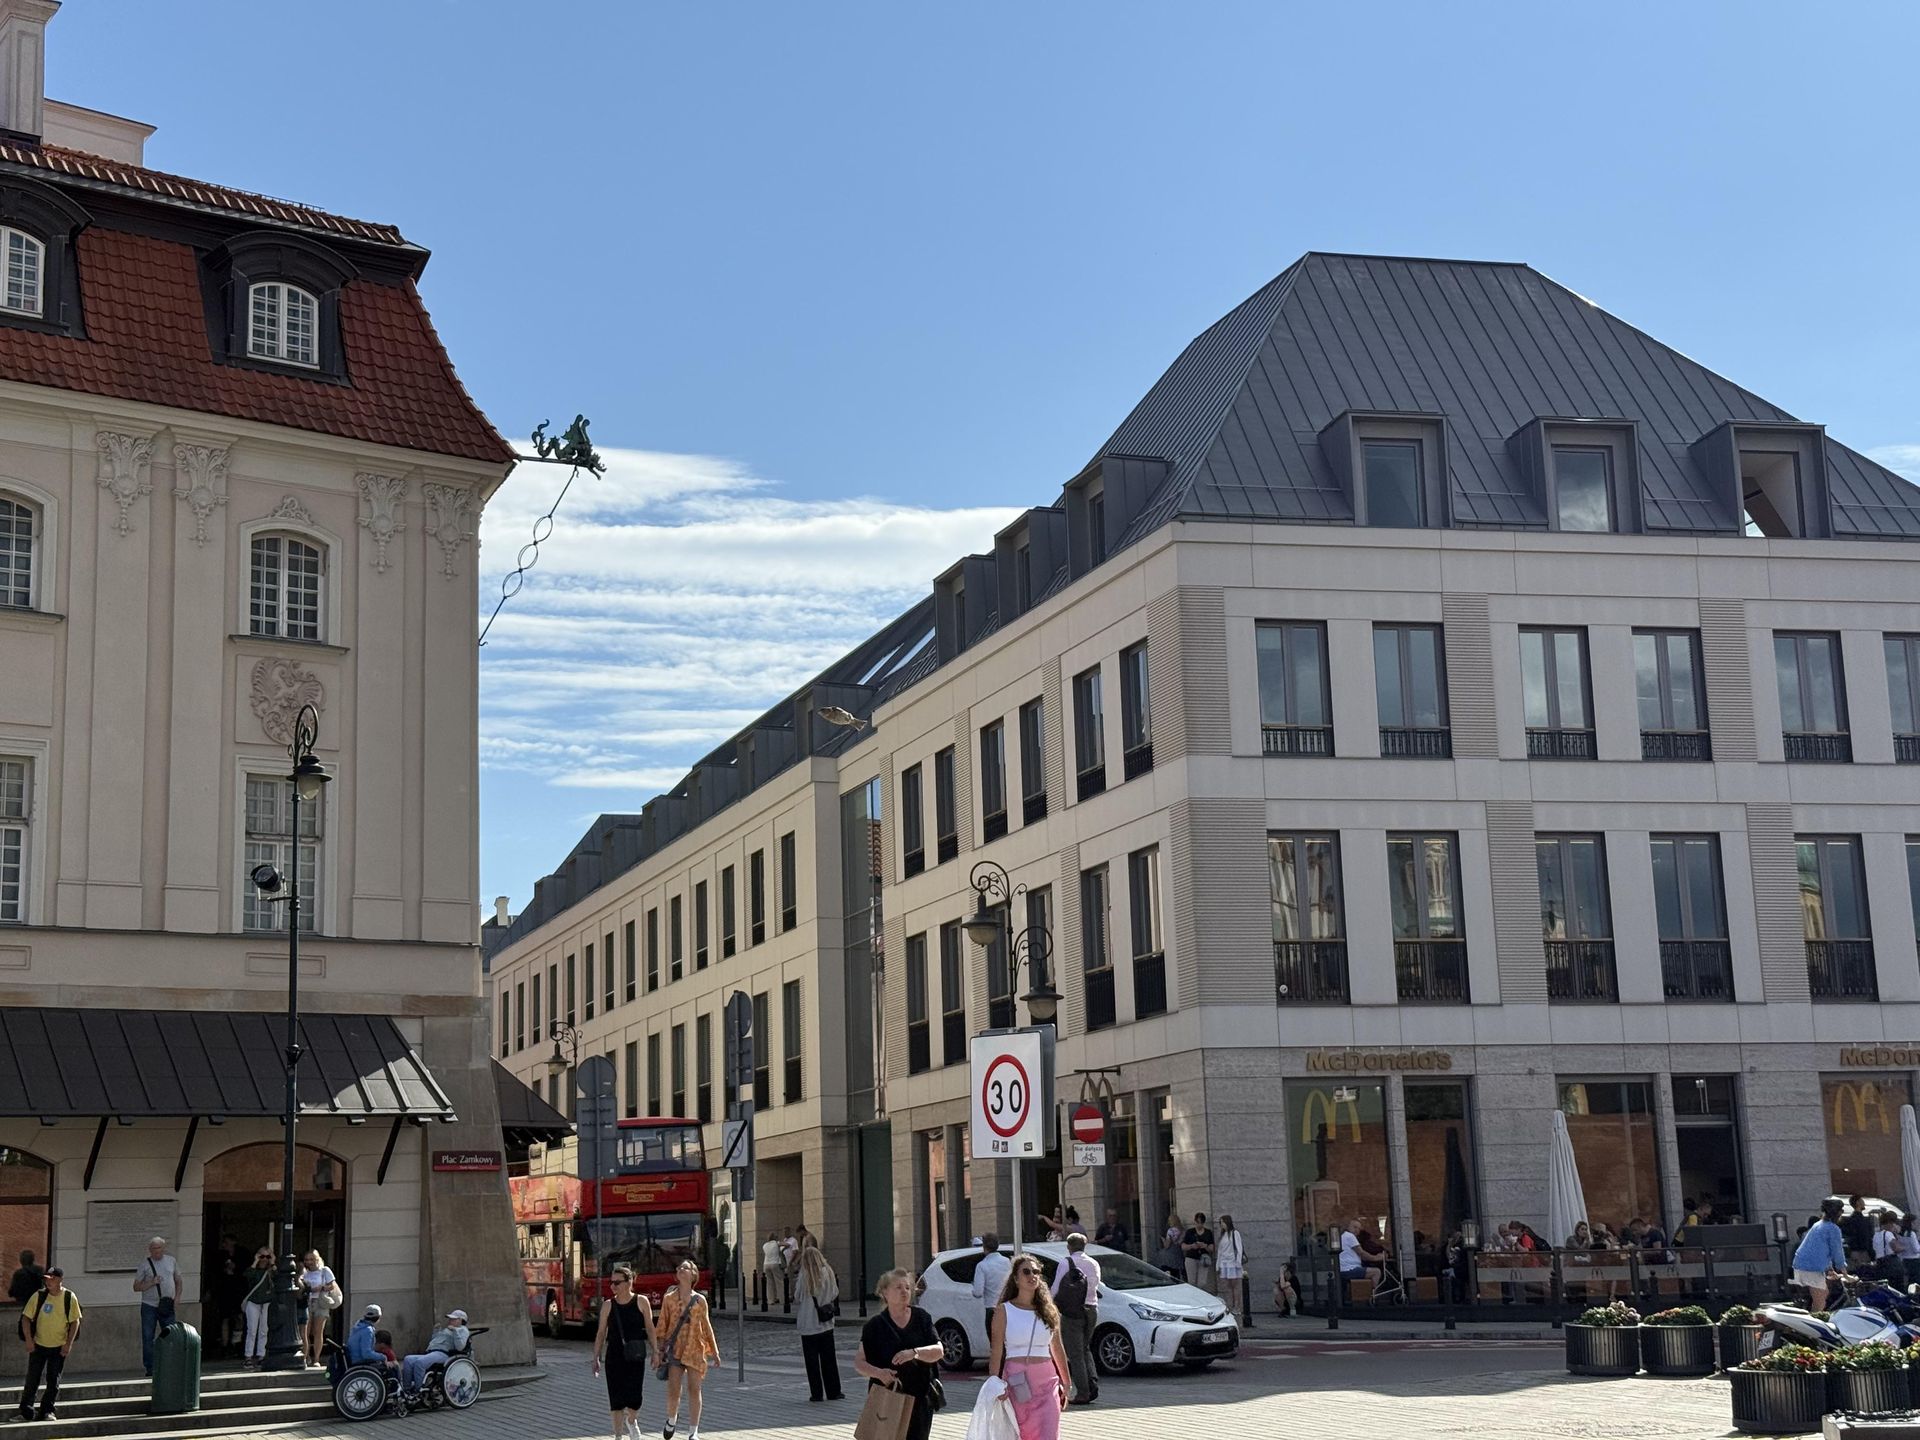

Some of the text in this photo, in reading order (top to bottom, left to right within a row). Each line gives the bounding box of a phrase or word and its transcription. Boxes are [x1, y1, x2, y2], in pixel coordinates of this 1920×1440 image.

[1306, 1051, 1453, 1072] McDonald's
[990, 1079, 1022, 1115] 30
[441, 1155, 494, 1166] Plac Zamkowy
